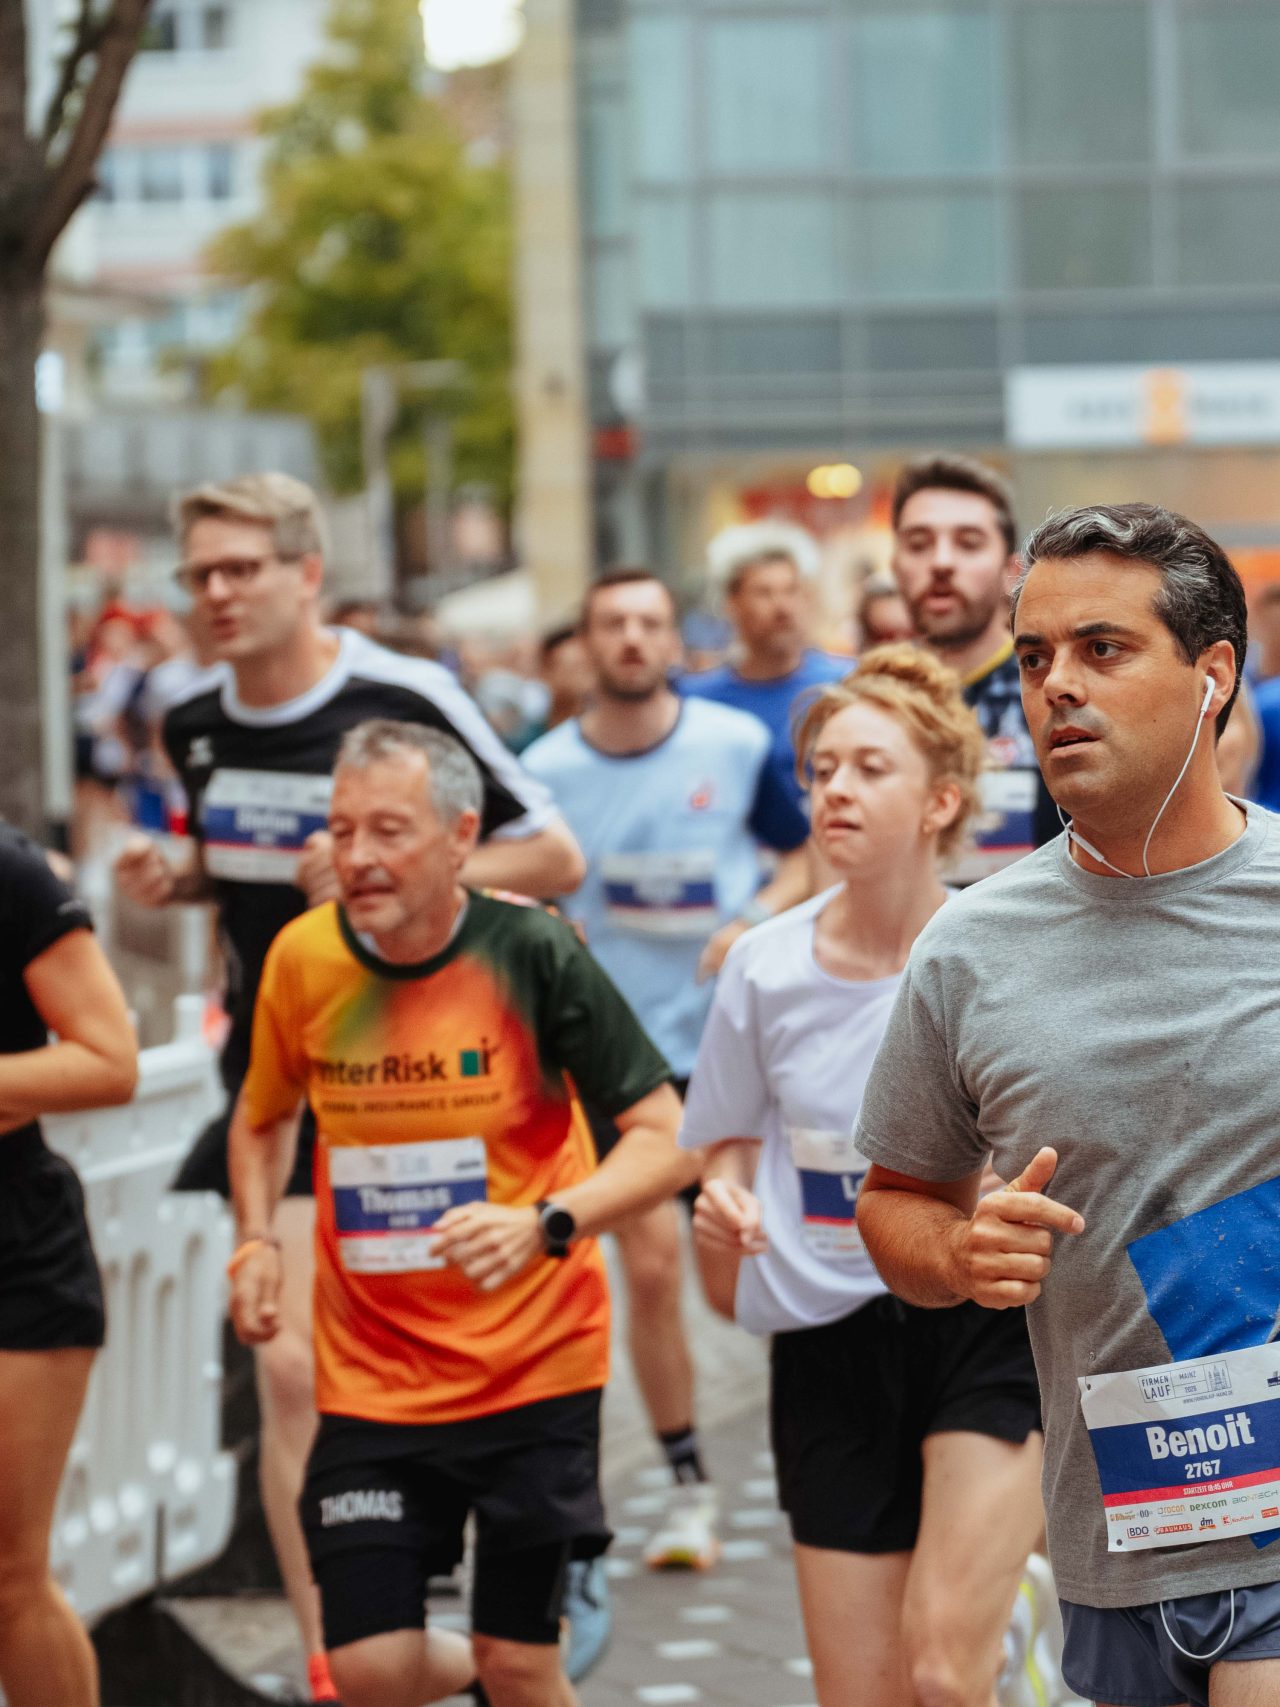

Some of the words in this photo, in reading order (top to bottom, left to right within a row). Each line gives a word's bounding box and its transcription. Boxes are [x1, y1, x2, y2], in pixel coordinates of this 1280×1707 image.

[313, 1051, 447, 1085] nterRisk
[356, 1185, 451, 1214] Thomas
[1141, 1375, 1170, 1388] FIRMEN
[1178, 1370, 1197, 1380] MAINZ
[1143, 1384, 1172, 1400] LAUF
[1145, 1411, 1256, 1460] Benoit
[1184, 1459, 1222, 1480] 2767
[1221, 1481, 1234, 1490] UHR
[319, 1490, 403, 1529] THOMAS
[1129, 1526, 1149, 1537] BDO
[1160, 1524, 1192, 1534] BAUHAUS
[1200, 1517, 1214, 1527] dm
